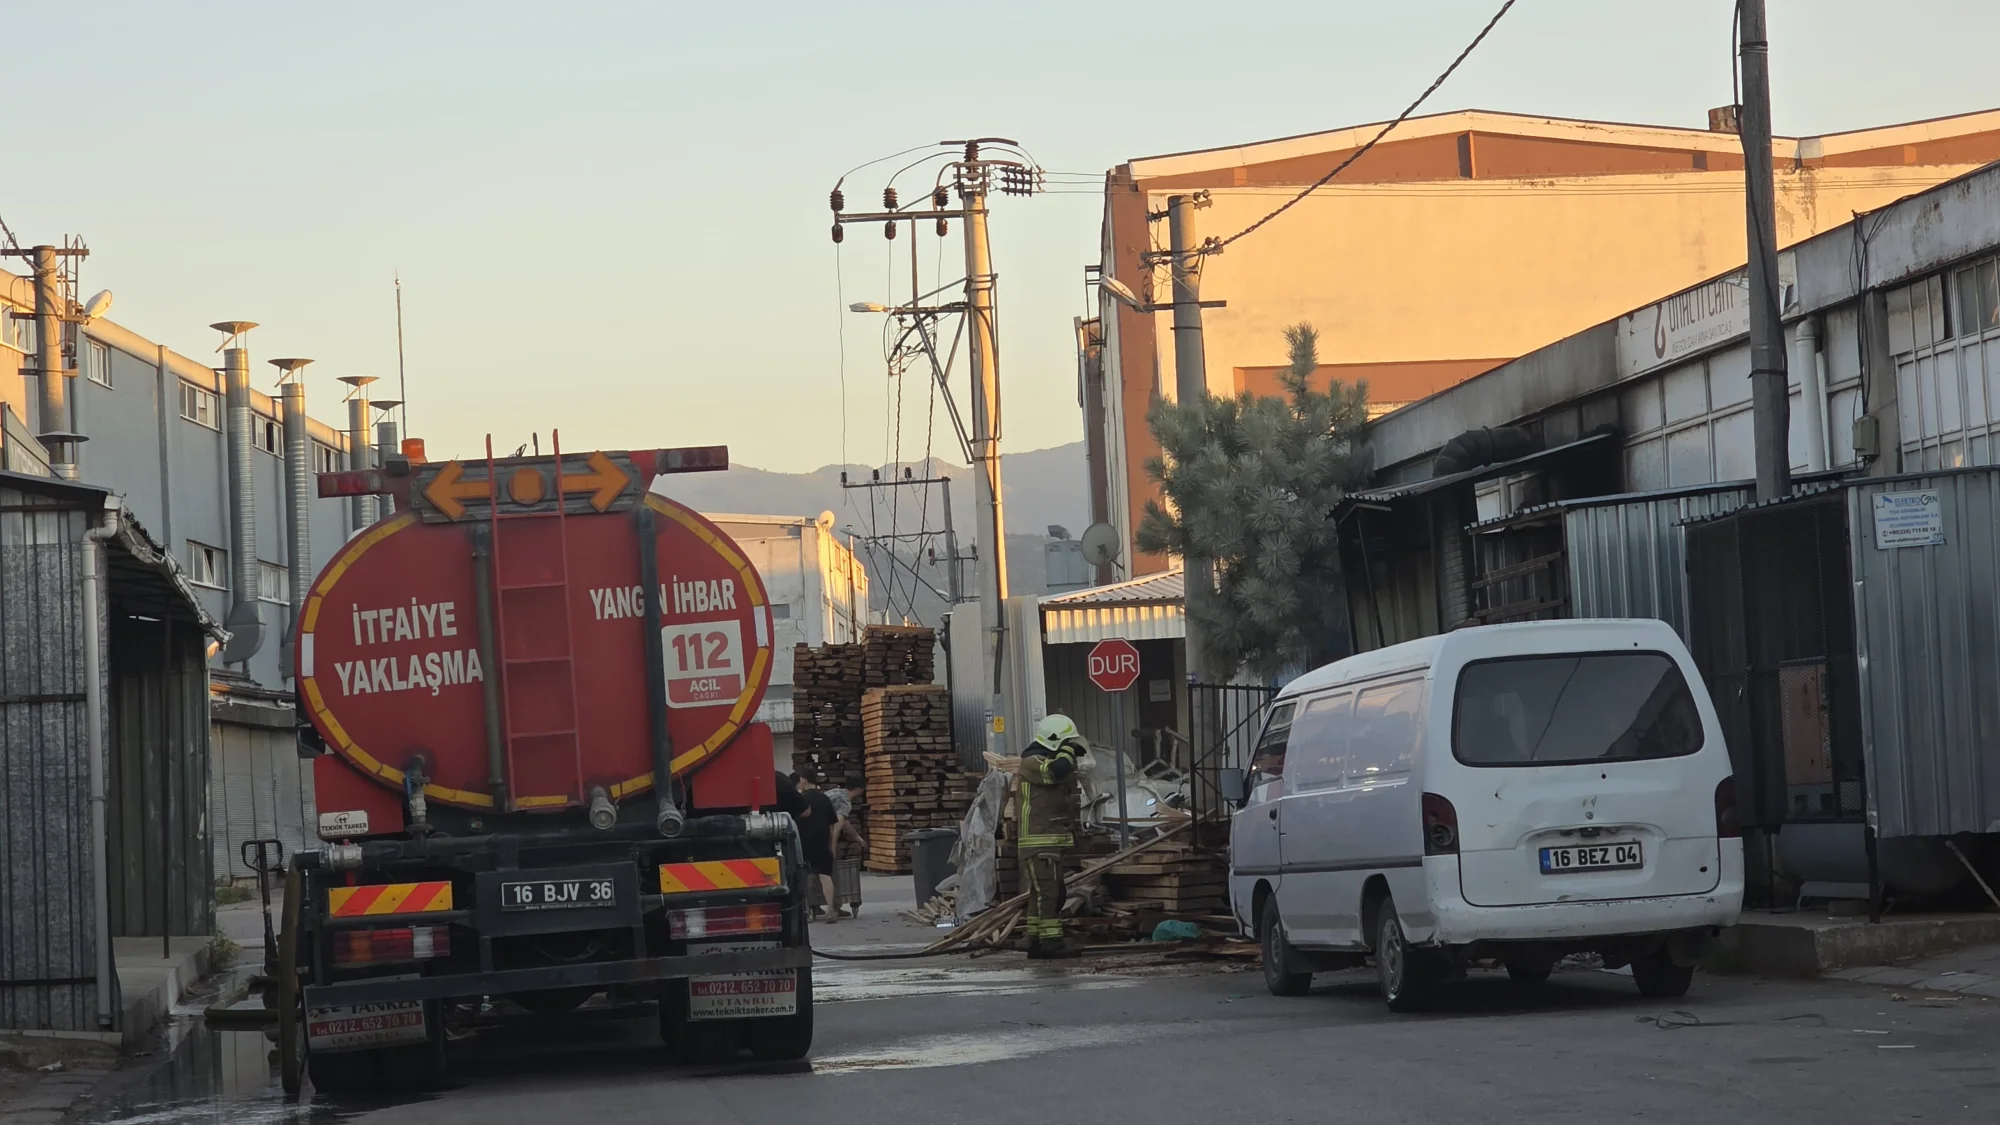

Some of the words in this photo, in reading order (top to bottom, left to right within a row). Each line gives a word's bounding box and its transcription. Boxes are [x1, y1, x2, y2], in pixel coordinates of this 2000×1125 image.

[589, 583, 668, 620] YANGN
[673, 574, 737, 614] İHBAR
[353, 597, 457, 645] İTFAİYE
[672, 631, 731, 671] 112
[333, 648, 484, 696] YAKLAŞMA
[1090, 654, 1137, 675] DUR
[344, 822, 367, 830] TANKER
[1552, 850, 1571, 867] 16
[1578, 847, 1610, 866] BEZ
[1615, 846, 1638, 863] 04
[513, 885, 533, 903] 16
[544, 882, 580, 902] BJV
[590, 881, 612, 899] 36
[741, 980, 760, 992] 652
[764, 979, 776, 992] 70
[780, 979, 791, 991] 70
[363, 1016, 383, 1030] 652
[387, 1014, 399, 1027] 70
[403, 1012, 416, 1024] 70
[692, 1004, 795, 1017] www.tekniktanker.com.tr
